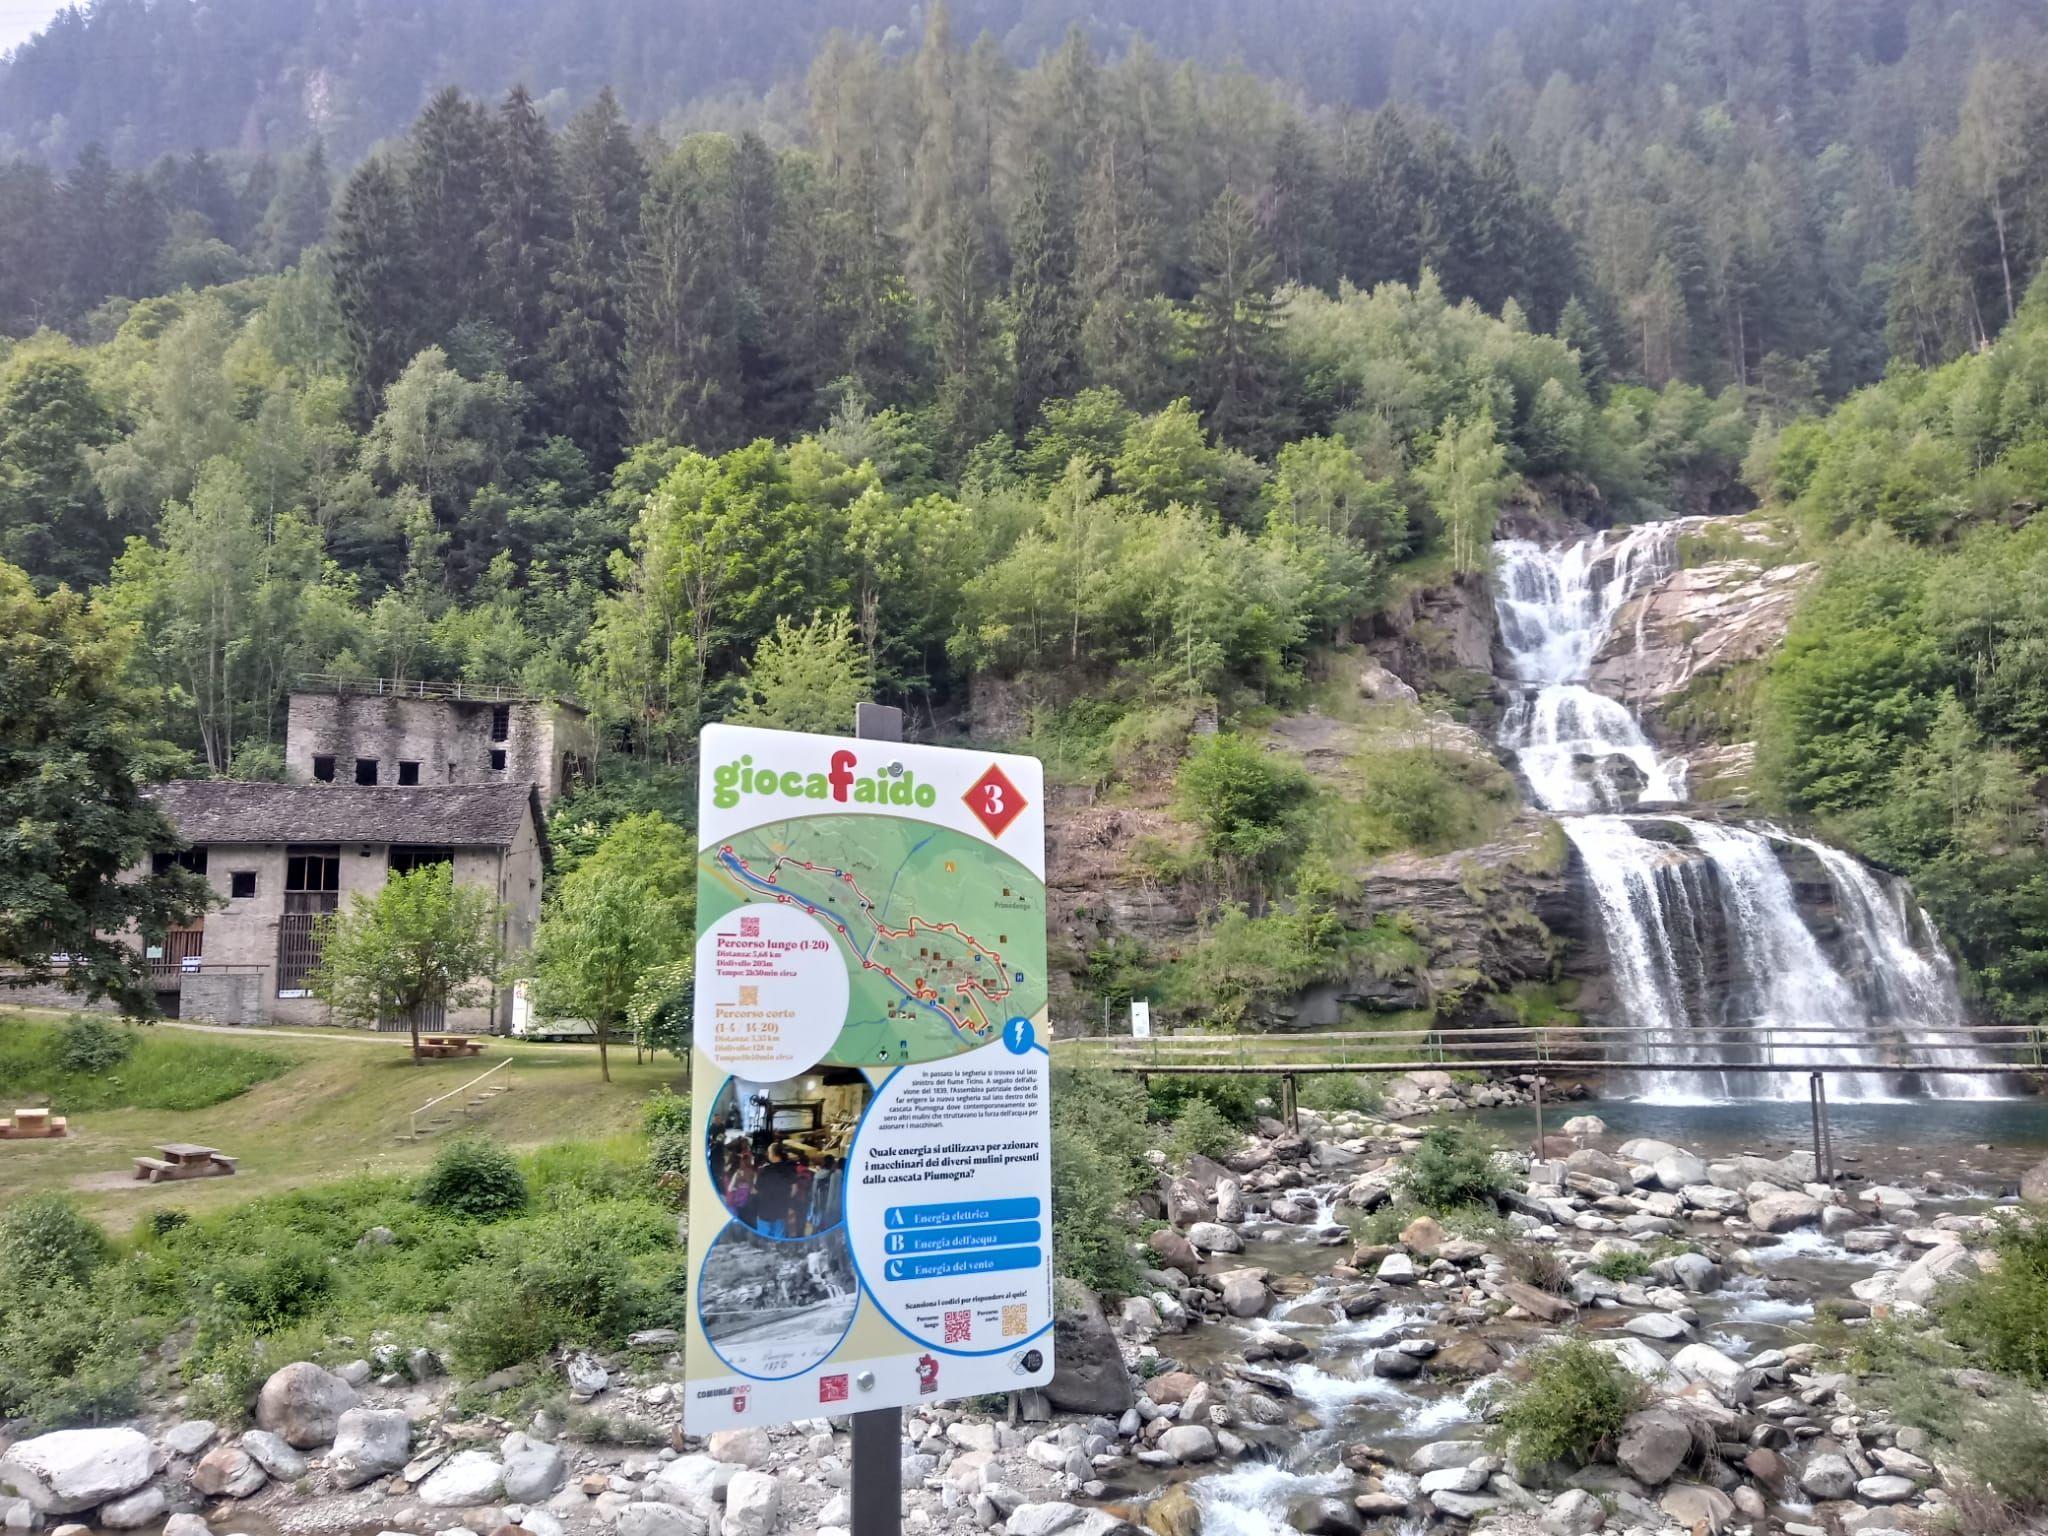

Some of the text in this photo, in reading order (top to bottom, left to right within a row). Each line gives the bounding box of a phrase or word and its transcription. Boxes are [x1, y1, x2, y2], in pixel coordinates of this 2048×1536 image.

[713, 750, 936, 808] giocafaido
[984, 784, 1004, 815] 3
[717, 938, 829, 951] Percorso lungo (1-20)
[716, 1008, 795, 1018] Percorso corto
[869, 1140, 1039, 1158] Quale energia si utilizzava per azionare
[871, 1159, 924, 1170] macchinari
[926, 1158, 940, 1167] dei
[941, 1156, 971, 1166] diversi
[974, 1154, 1002, 1164] mulini
[1004, 1152, 1039, 1165] presenti
[862, 1169, 975, 1184] dalla cascata Piumogna?
[891, 1208, 989, 1224] A Energia elettrica
[891, 1234, 997, 1251] B Energia dell'acqua
[890, 1260, 994, 1277] C Energia del vento
[941, 1298, 960, 1306] codici
